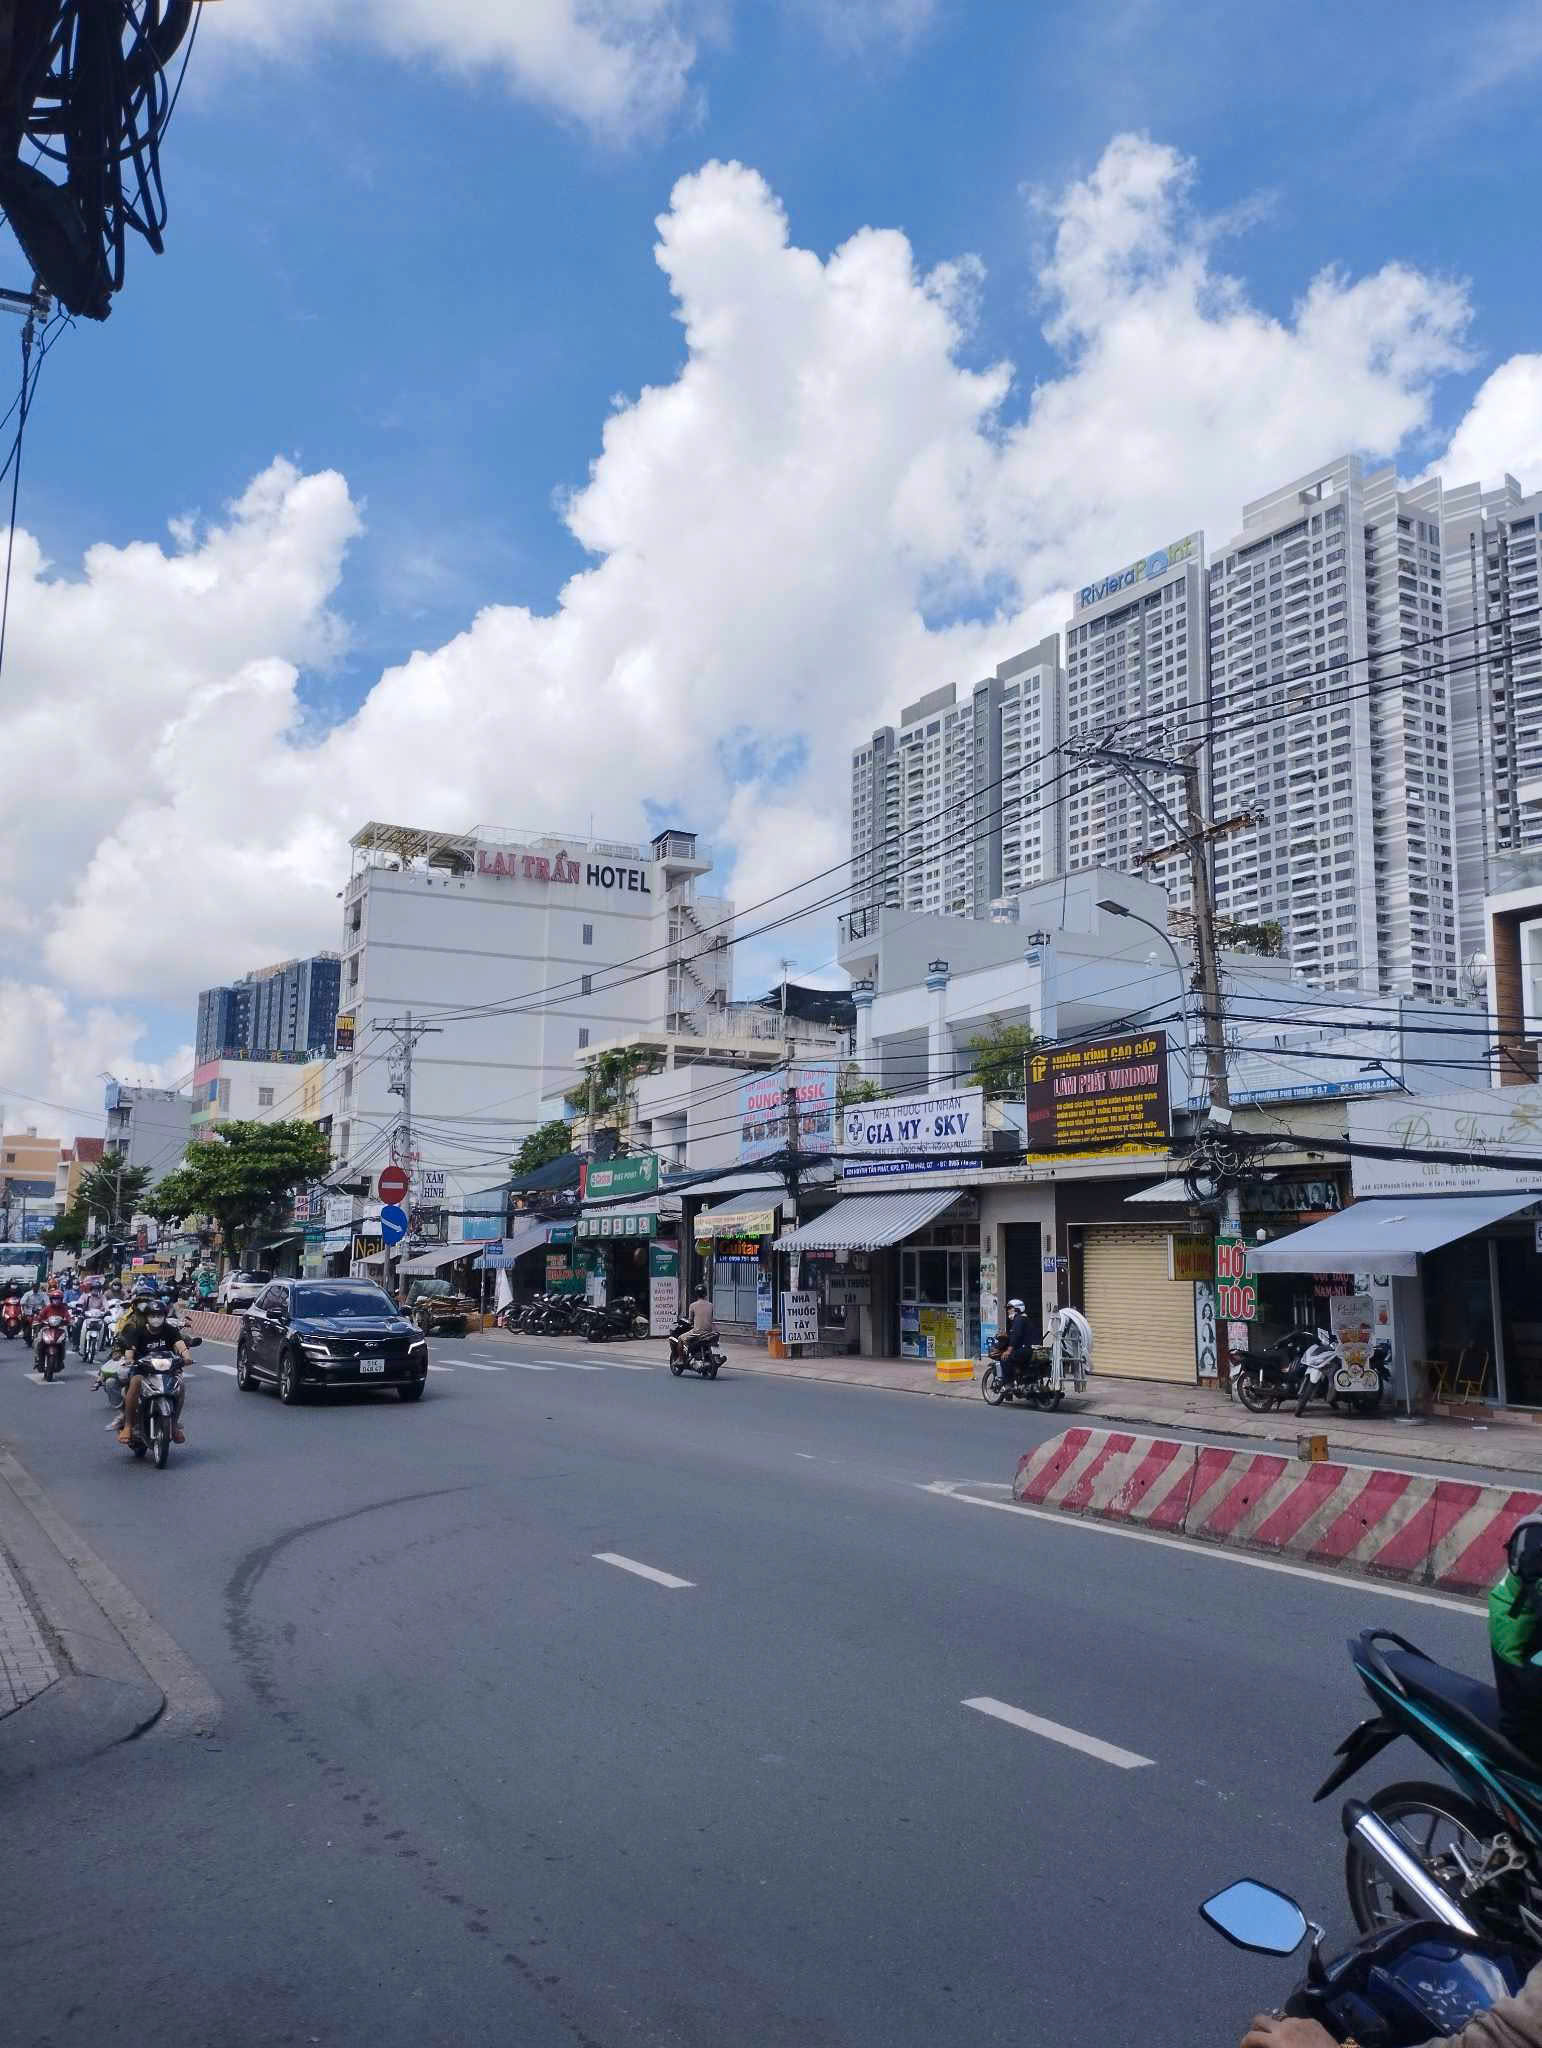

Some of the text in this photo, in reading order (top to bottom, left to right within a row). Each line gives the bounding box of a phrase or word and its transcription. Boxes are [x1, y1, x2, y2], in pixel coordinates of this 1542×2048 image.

[586, 863, 651, 893] HOTEL
[1079, 1070, 1107, 1093] PHÁT
[1108, 1064, 1159, 1090] WINDOW
[866, 1121, 894, 1144] GIA
[898, 1118, 922, 1141] MY
[792, 1293, 811, 1303] NHÀ
[1218, 1279, 1255, 1320] TÓC
[787, 1306, 816, 1317] THUỐC
[788, 1332, 802, 1342] GIA
